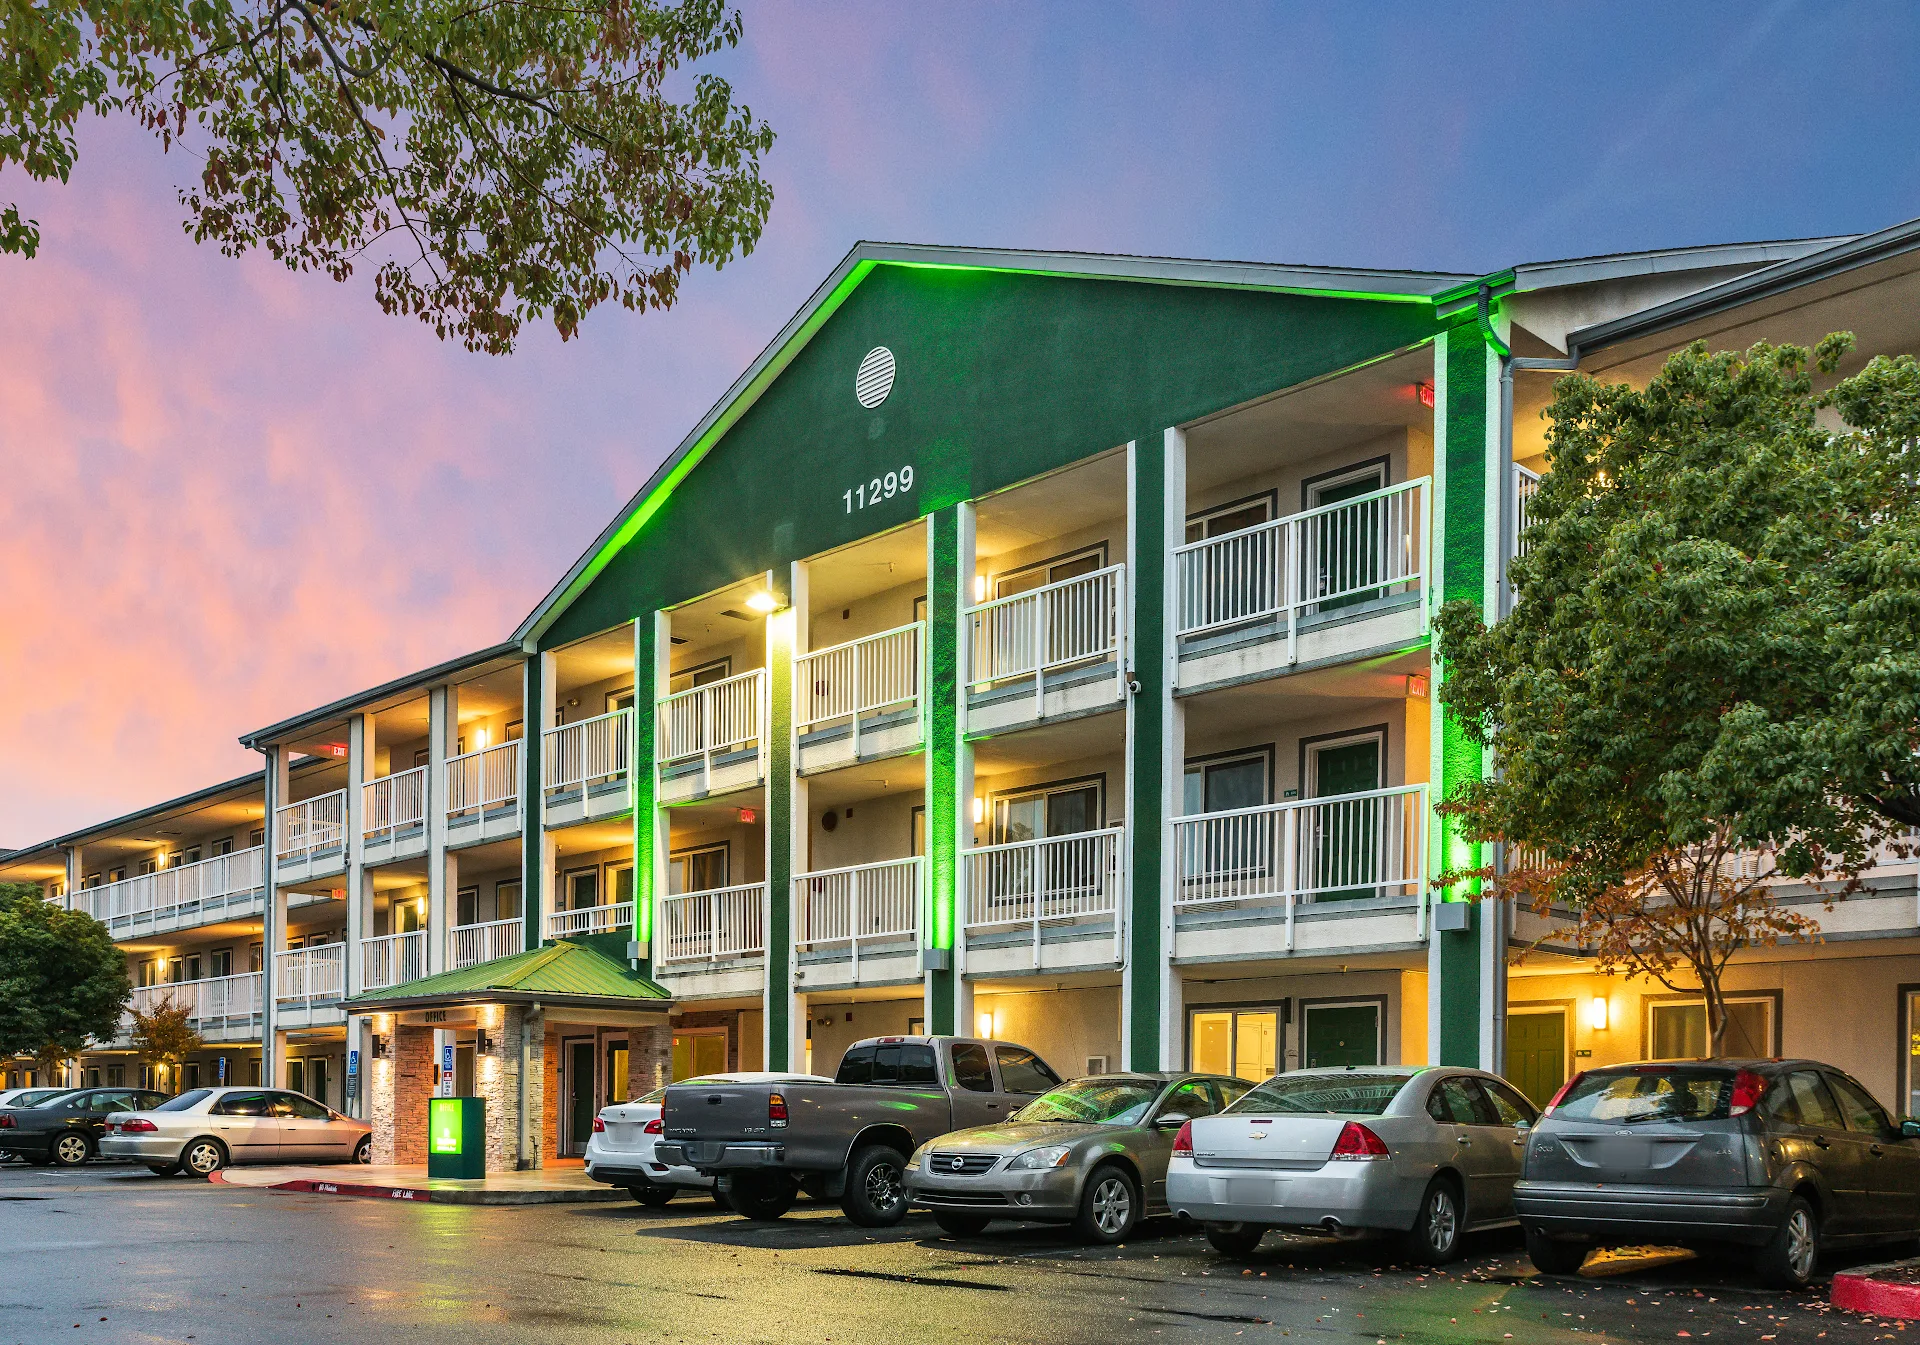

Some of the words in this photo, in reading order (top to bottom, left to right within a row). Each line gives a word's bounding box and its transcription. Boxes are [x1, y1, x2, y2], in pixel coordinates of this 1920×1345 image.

[842, 465, 914, 514] 11299
[333, 746, 345, 756] EXIT
[425, 1010, 447, 1023] OFFICE
